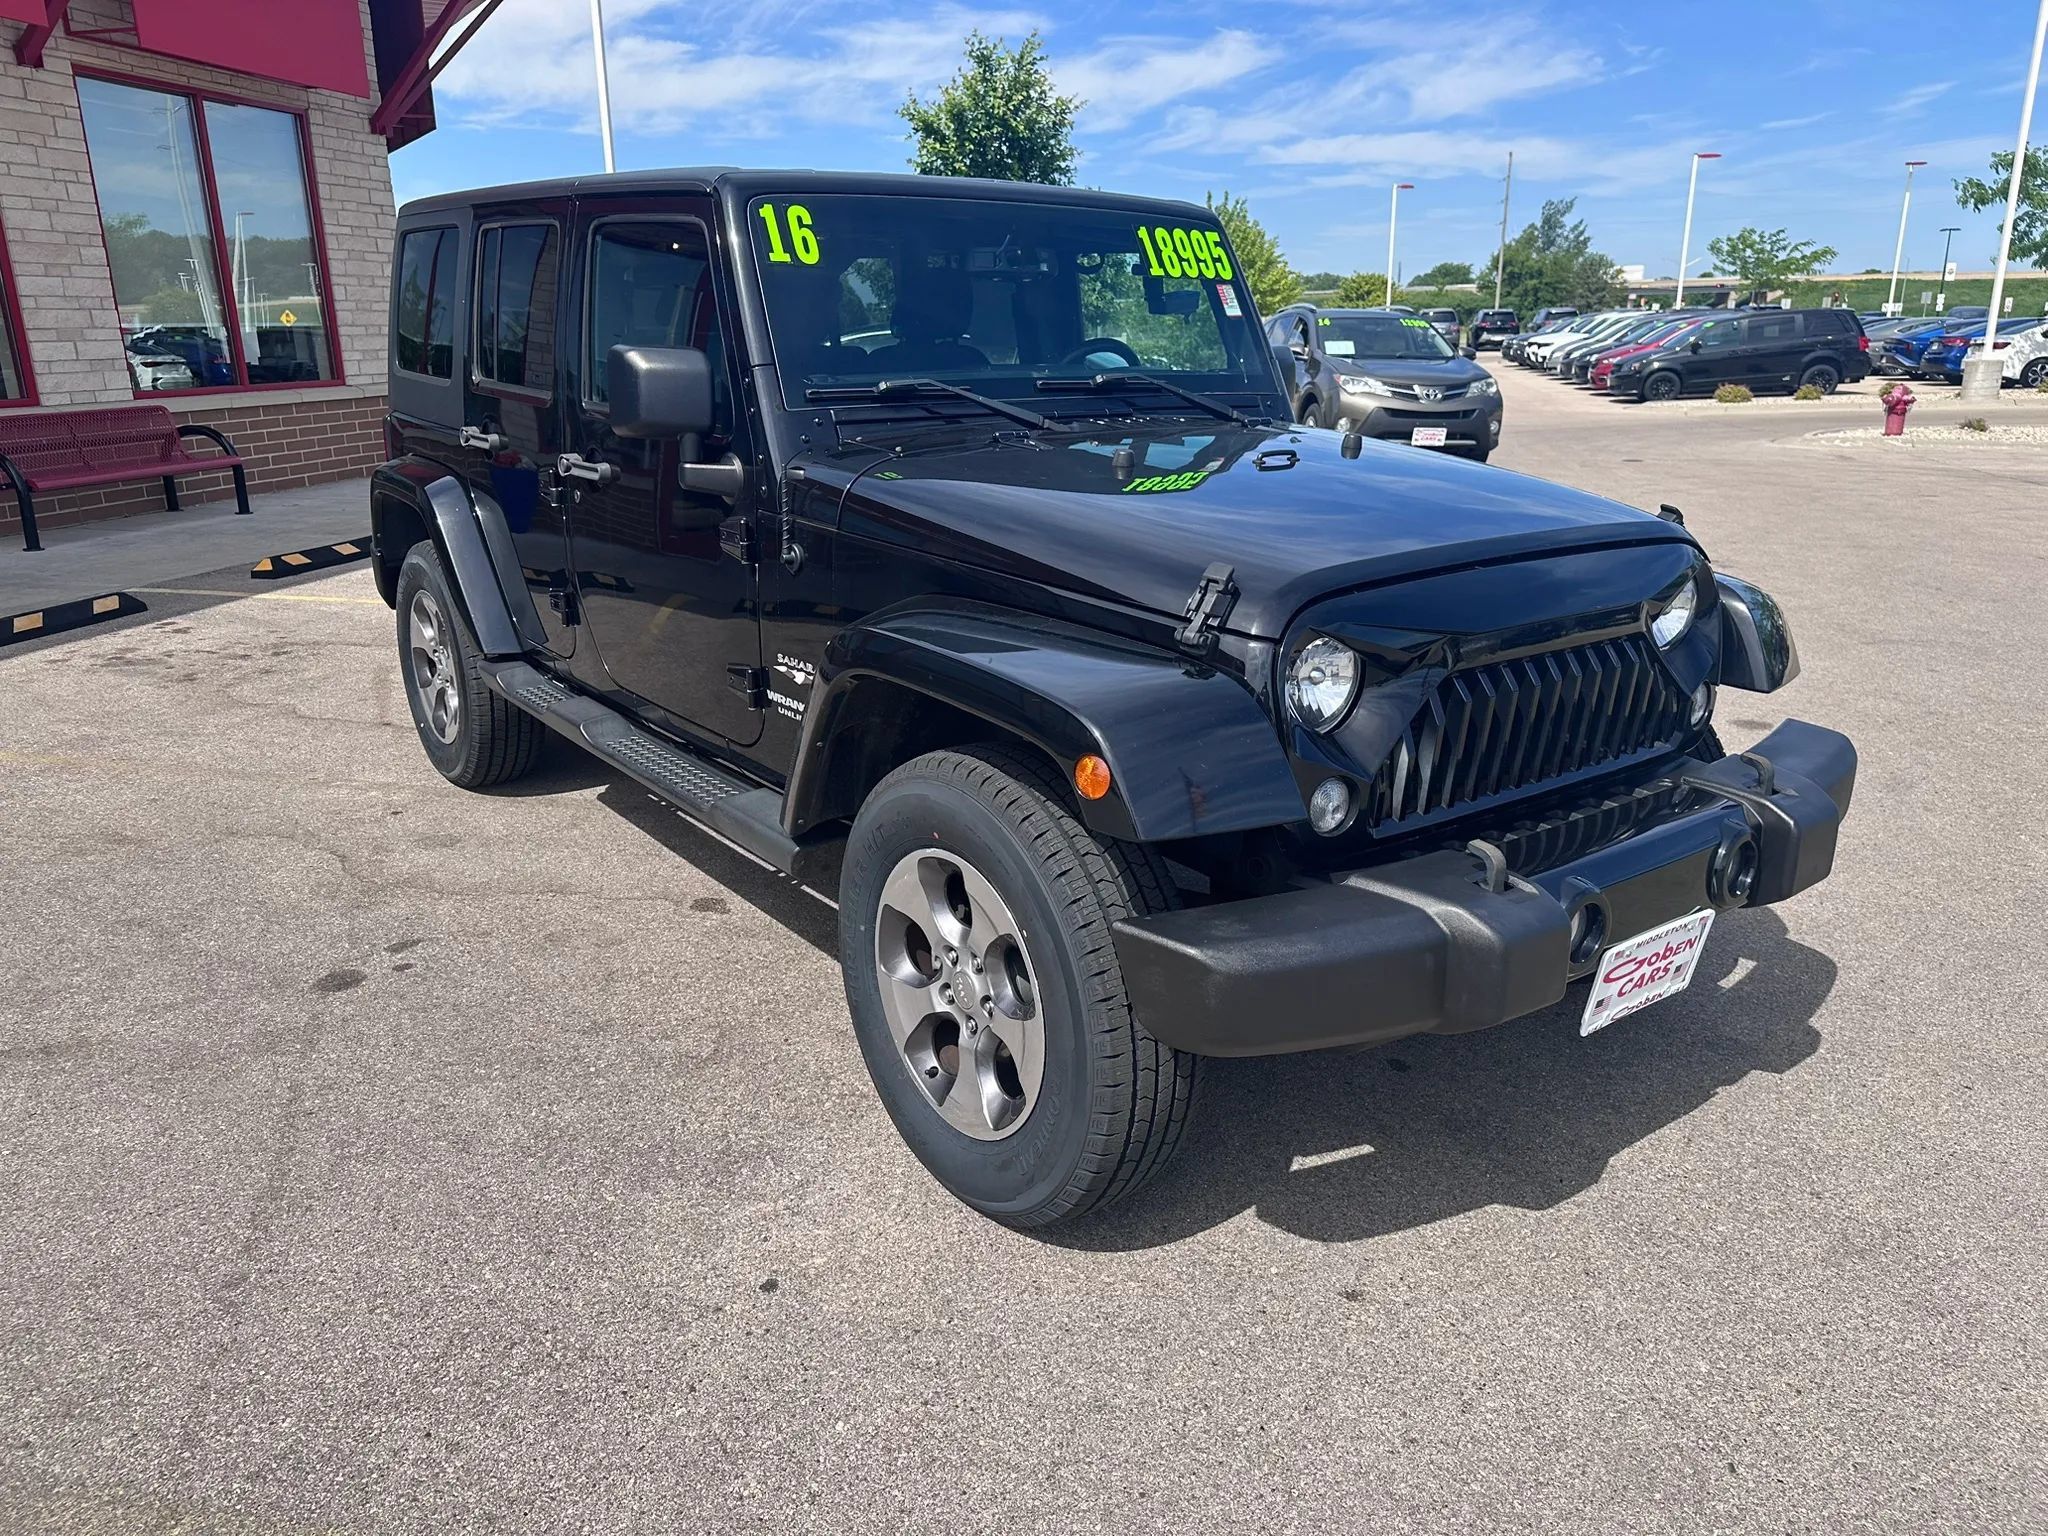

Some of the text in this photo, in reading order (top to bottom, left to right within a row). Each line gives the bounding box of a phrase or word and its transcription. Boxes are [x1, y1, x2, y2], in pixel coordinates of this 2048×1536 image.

[759, 203, 820, 265] 16
[1137, 226, 1233, 280] 18995
[777, 653, 816, 674] SAHAR
[1635, 923, 1689, 949] MIDDLETON
[1616, 960, 1675, 998] CARS
